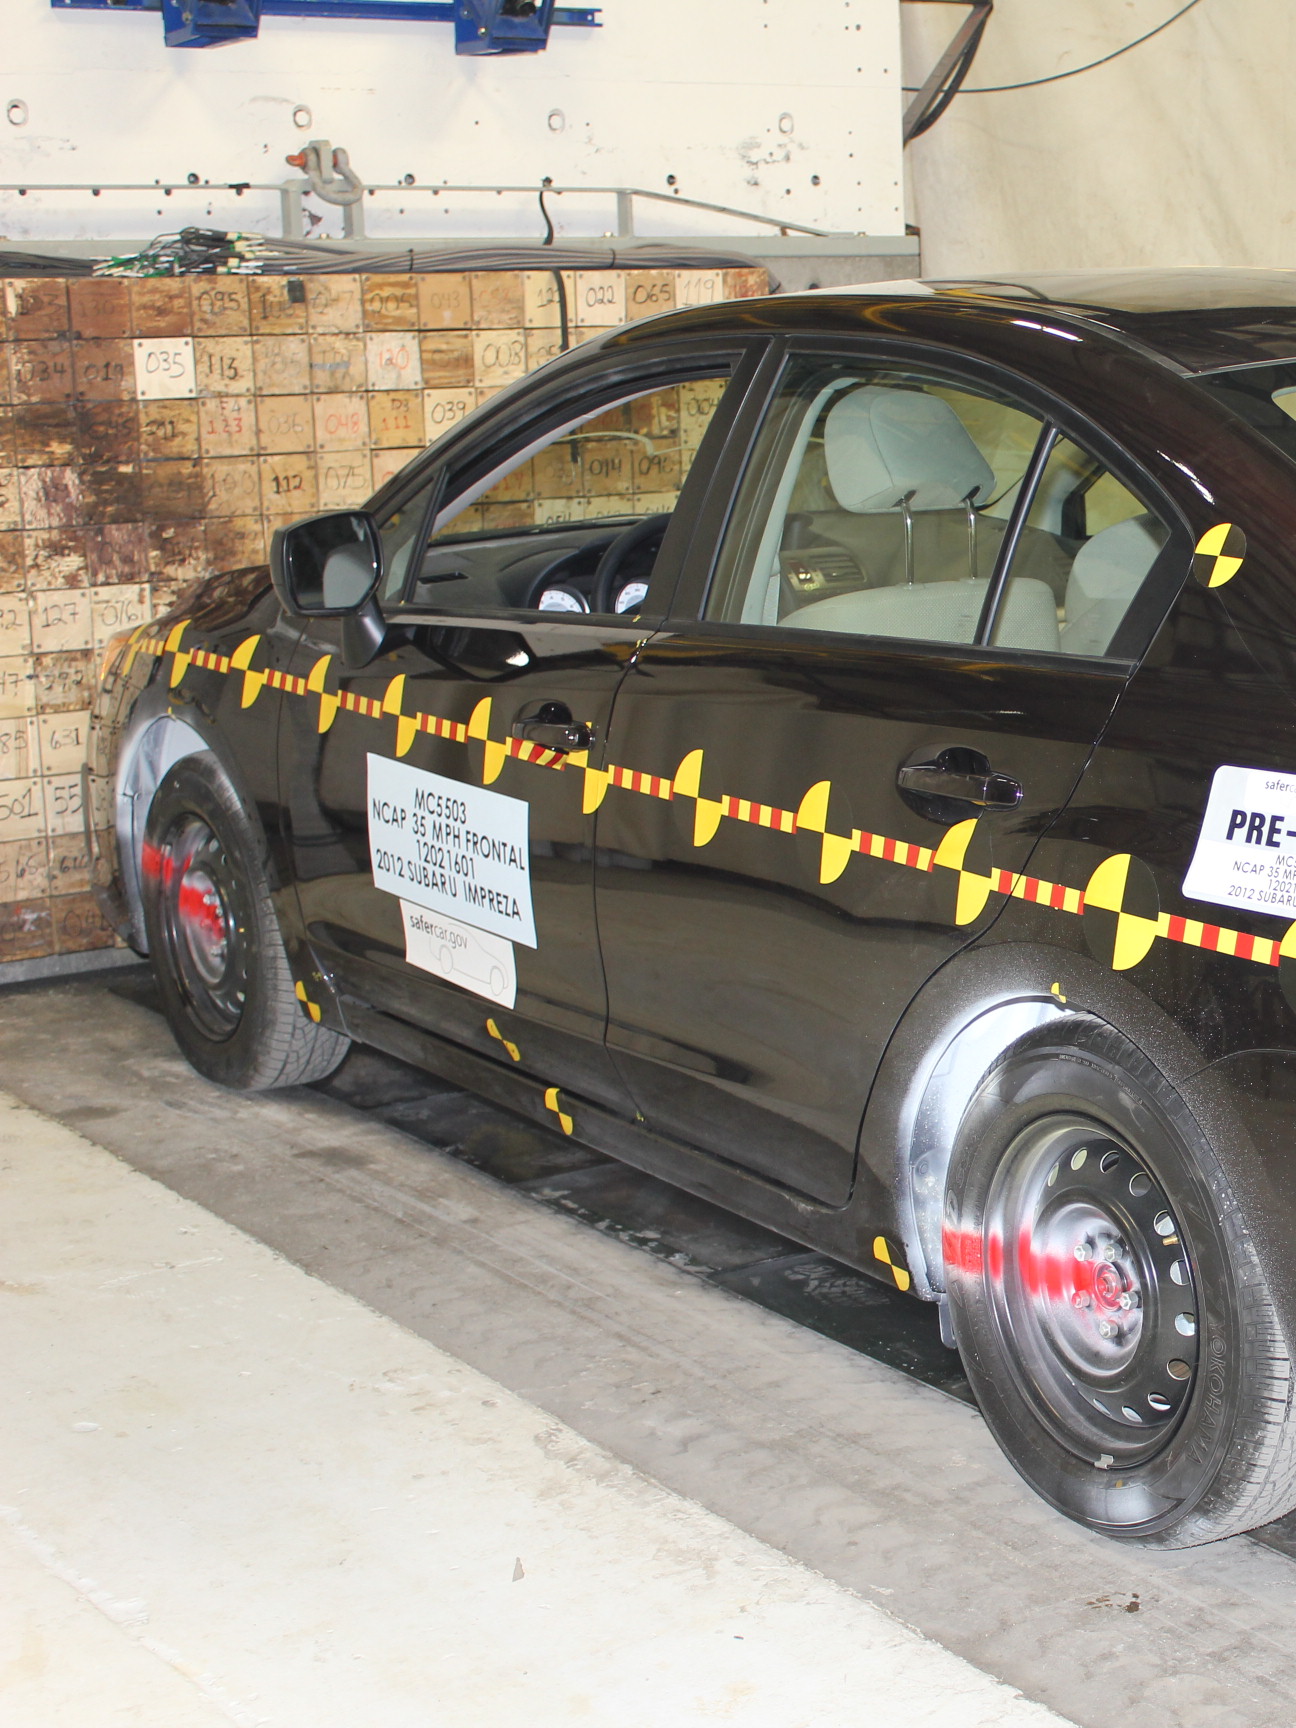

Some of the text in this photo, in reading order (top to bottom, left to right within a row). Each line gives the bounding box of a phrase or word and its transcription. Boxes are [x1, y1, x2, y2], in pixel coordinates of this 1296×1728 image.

[586, 285, 617, 307] 022
[633, 283, 671, 305] 065
[682, 278, 715, 307] 119
[146, 351, 185, 378] 035
[208, 354, 239, 380] 113
[325, 412, 360, 435] 048
[382, 414, 412, 433] 111
[431, 400, 467, 424] 039
[207, 416, 244, 435] 123
[325, 464, 366, 491] 075
[589, 459, 623, 478] 014
[272, 474, 304, 495] 112
[41, 602, 78, 628] 127
[51, 727, 82, 750] 631
[414, 788, 467, 825] MC5503
[373, 798, 525, 871] NCAP 35 MPH FRONTAL
[416, 839, 475, 880] 12021601
[1233, 860, 1265, 875] NCAP
[1267, 866, 1280, 878] 35
[376, 849, 522, 921] 2012 SUBARU IMPREZA
[1227, 885, 1254, 900] 2012
[410, 915, 468, 951] safercar.gov
[1186, 1323, 1227, 1465] YOKOHAMA
